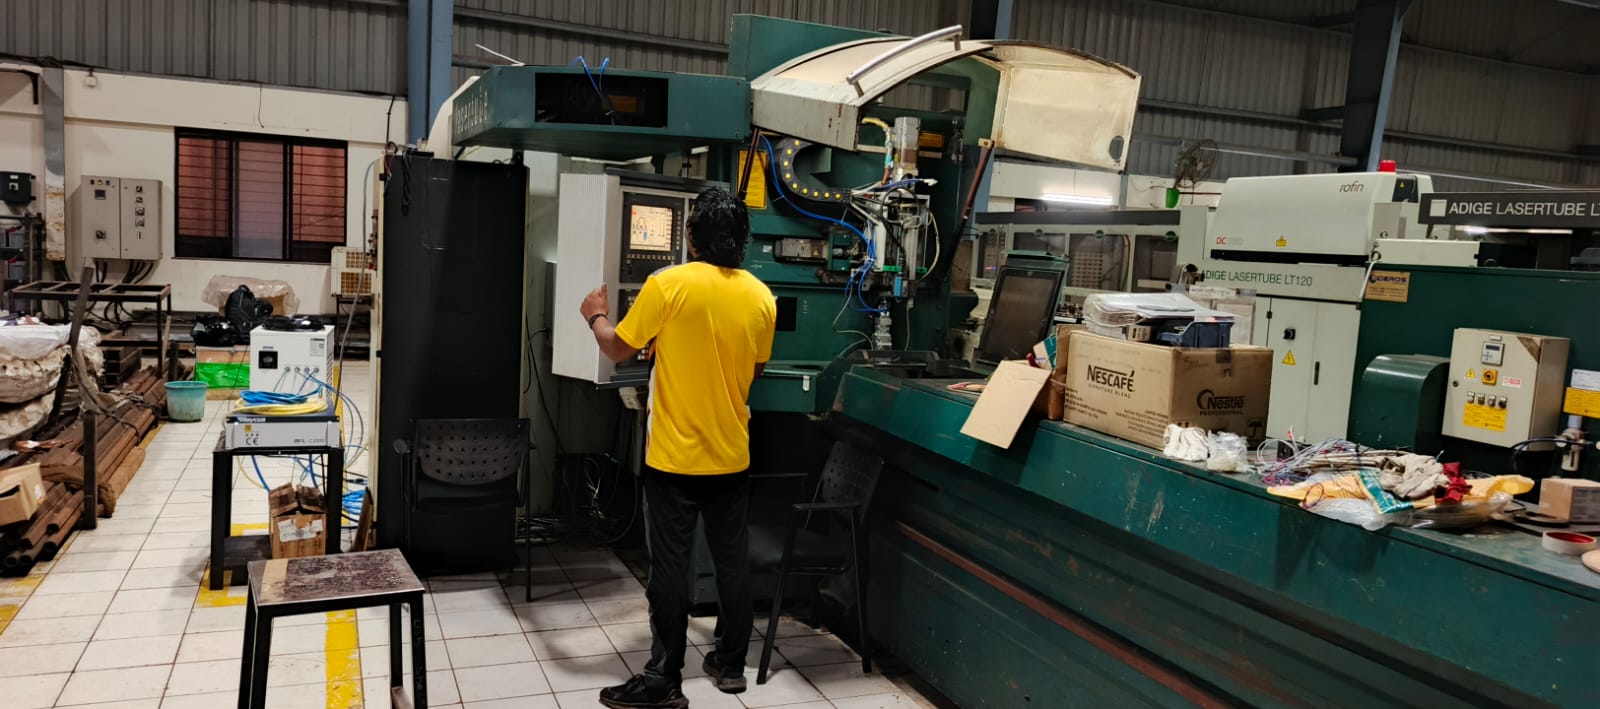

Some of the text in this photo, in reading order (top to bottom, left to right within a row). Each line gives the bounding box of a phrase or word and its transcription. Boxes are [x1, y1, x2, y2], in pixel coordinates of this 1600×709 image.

[1339, 180, 1364, 192] rofin
[1449, 202, 1600, 216] ADIGE LASERTUBE L
[1216, 237, 1227, 245] DC
[1228, 272, 1282, 284] LASERTUBE
[1284, 275, 1312, 287] LT120
